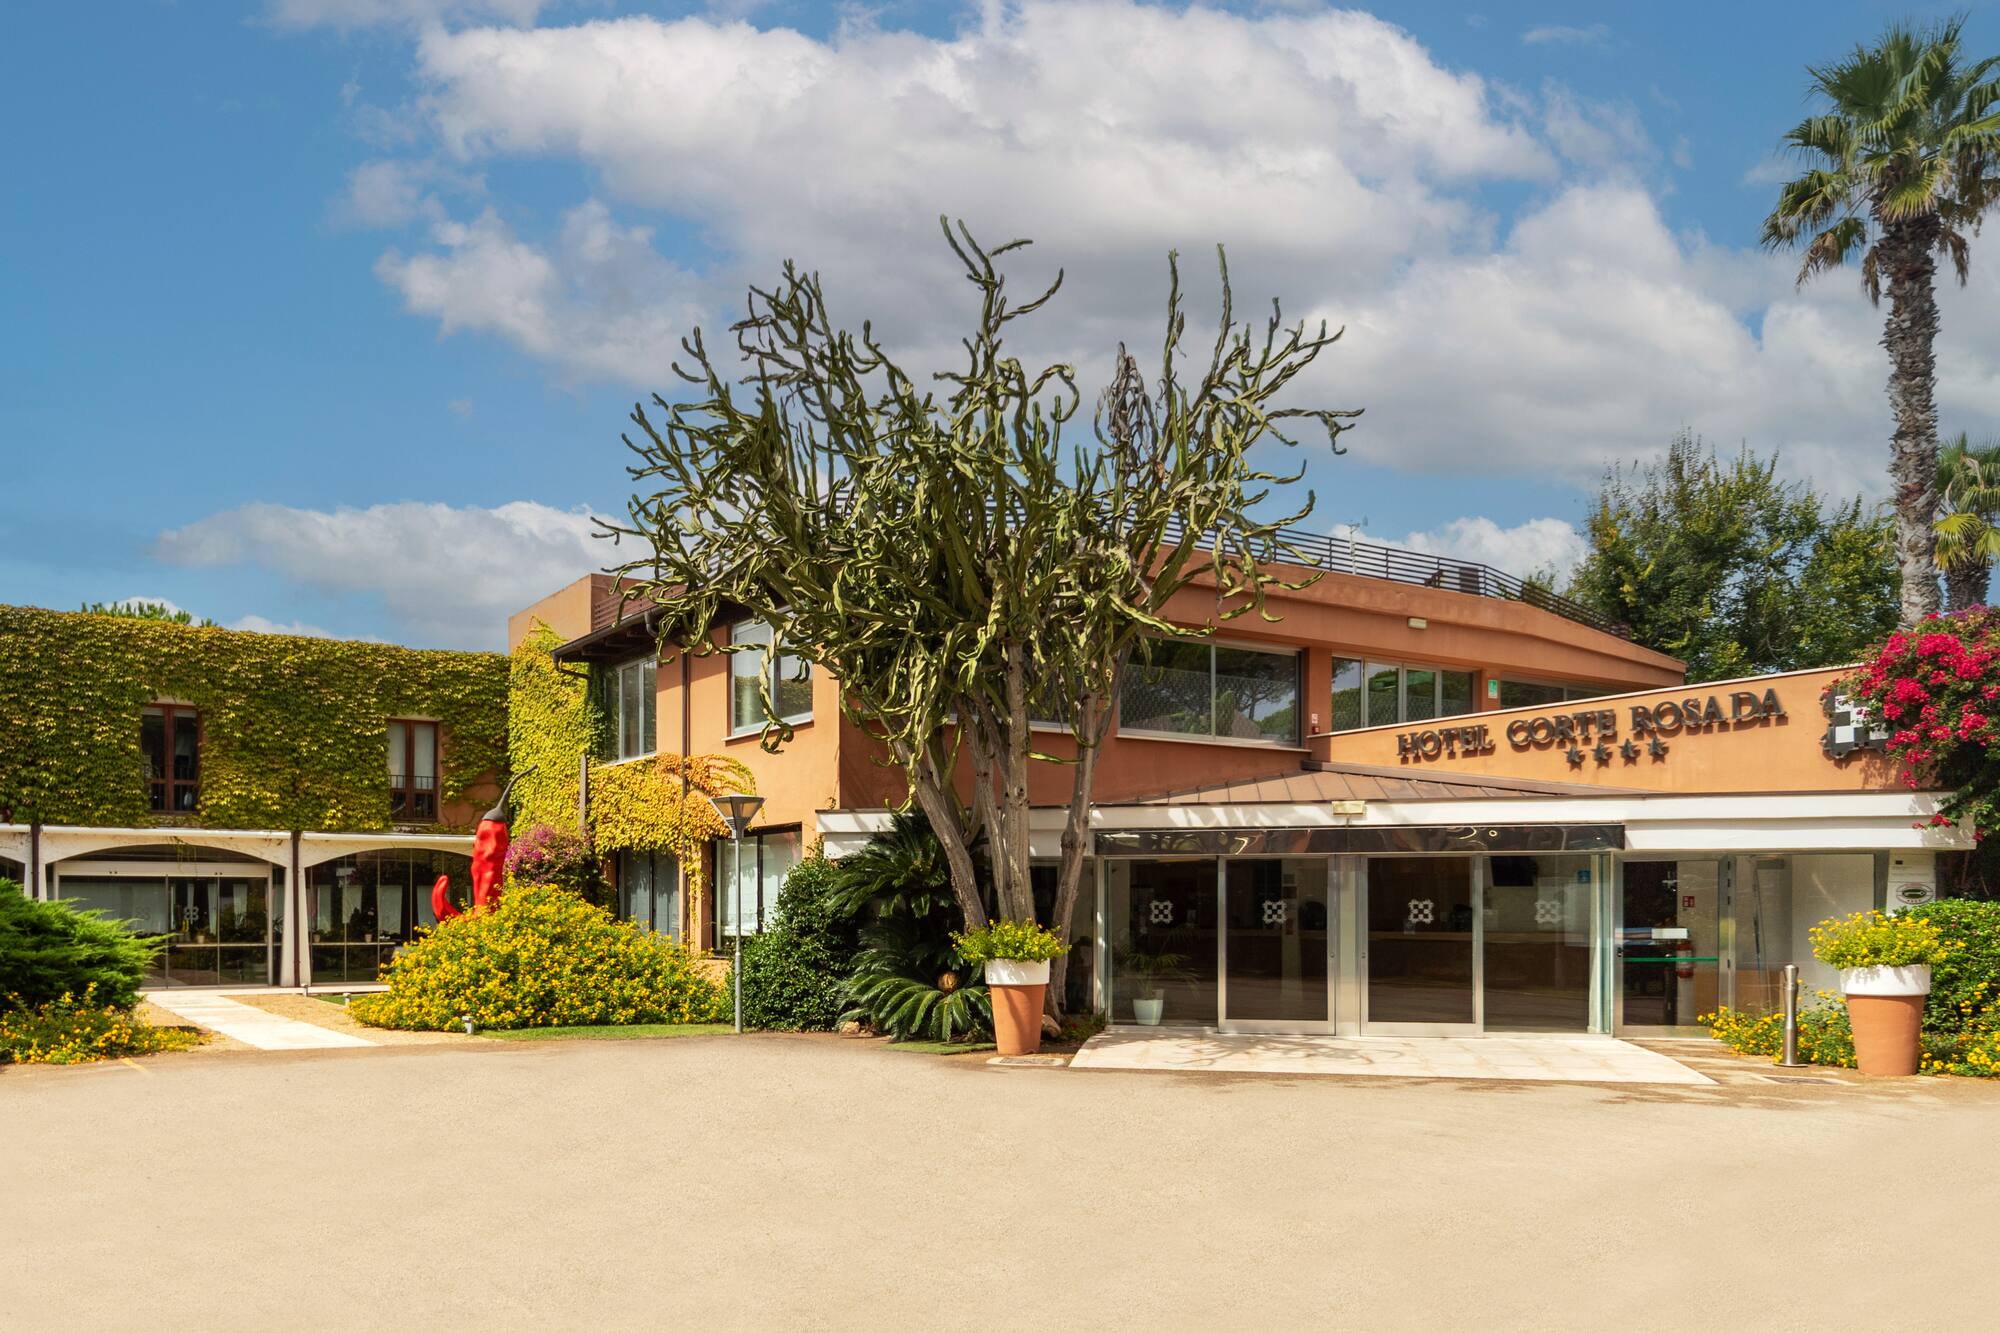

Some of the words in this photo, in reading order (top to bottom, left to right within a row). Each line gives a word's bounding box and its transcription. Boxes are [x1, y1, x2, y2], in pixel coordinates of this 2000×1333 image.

[1396, 724, 1494, 757] HOTEL
[1506, 710, 1616, 746] CORTE
[1629, 688, 1787, 731] ROSADA
